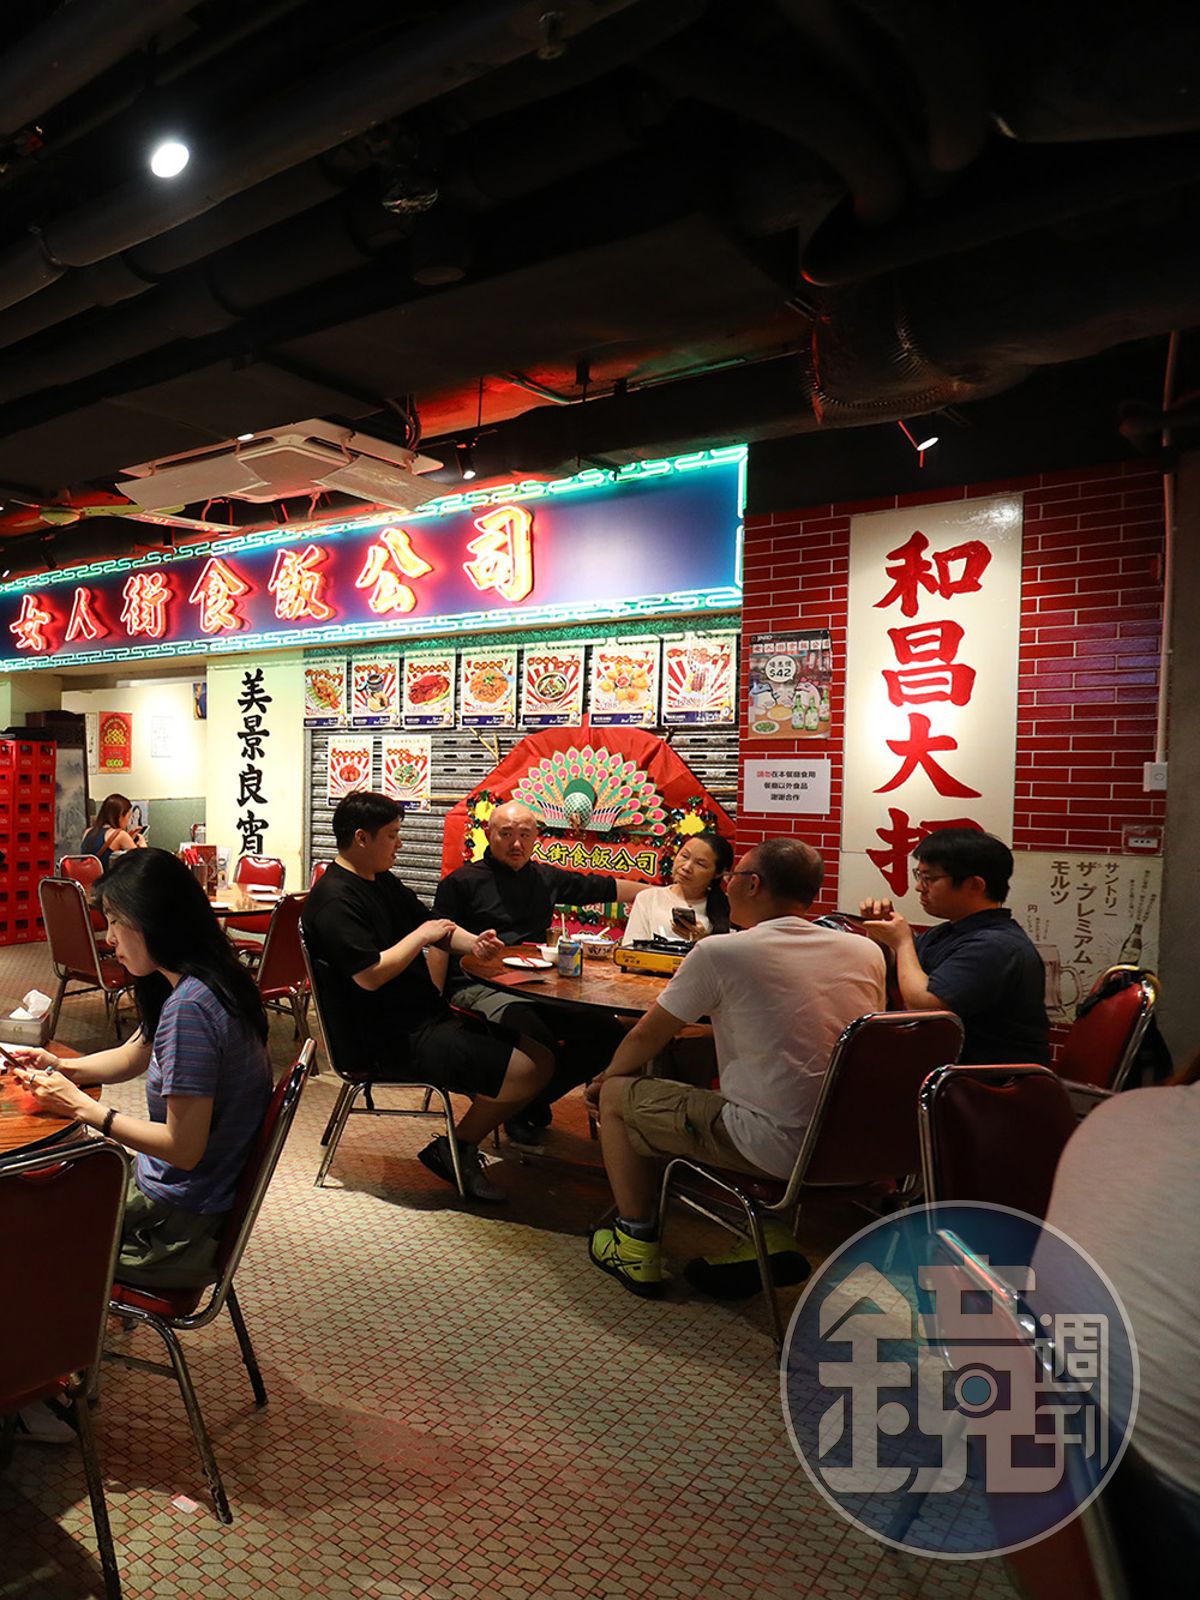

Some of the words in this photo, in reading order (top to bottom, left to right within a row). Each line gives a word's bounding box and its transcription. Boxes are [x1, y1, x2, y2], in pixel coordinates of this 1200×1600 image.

[8, 505, 534, 653] 女人街食飯公司
[236, 668, 273, 856] 美景良宵
[532, 841, 657, 876] 人街食飯公司
[1050, 860, 1071, 905] モルツ
